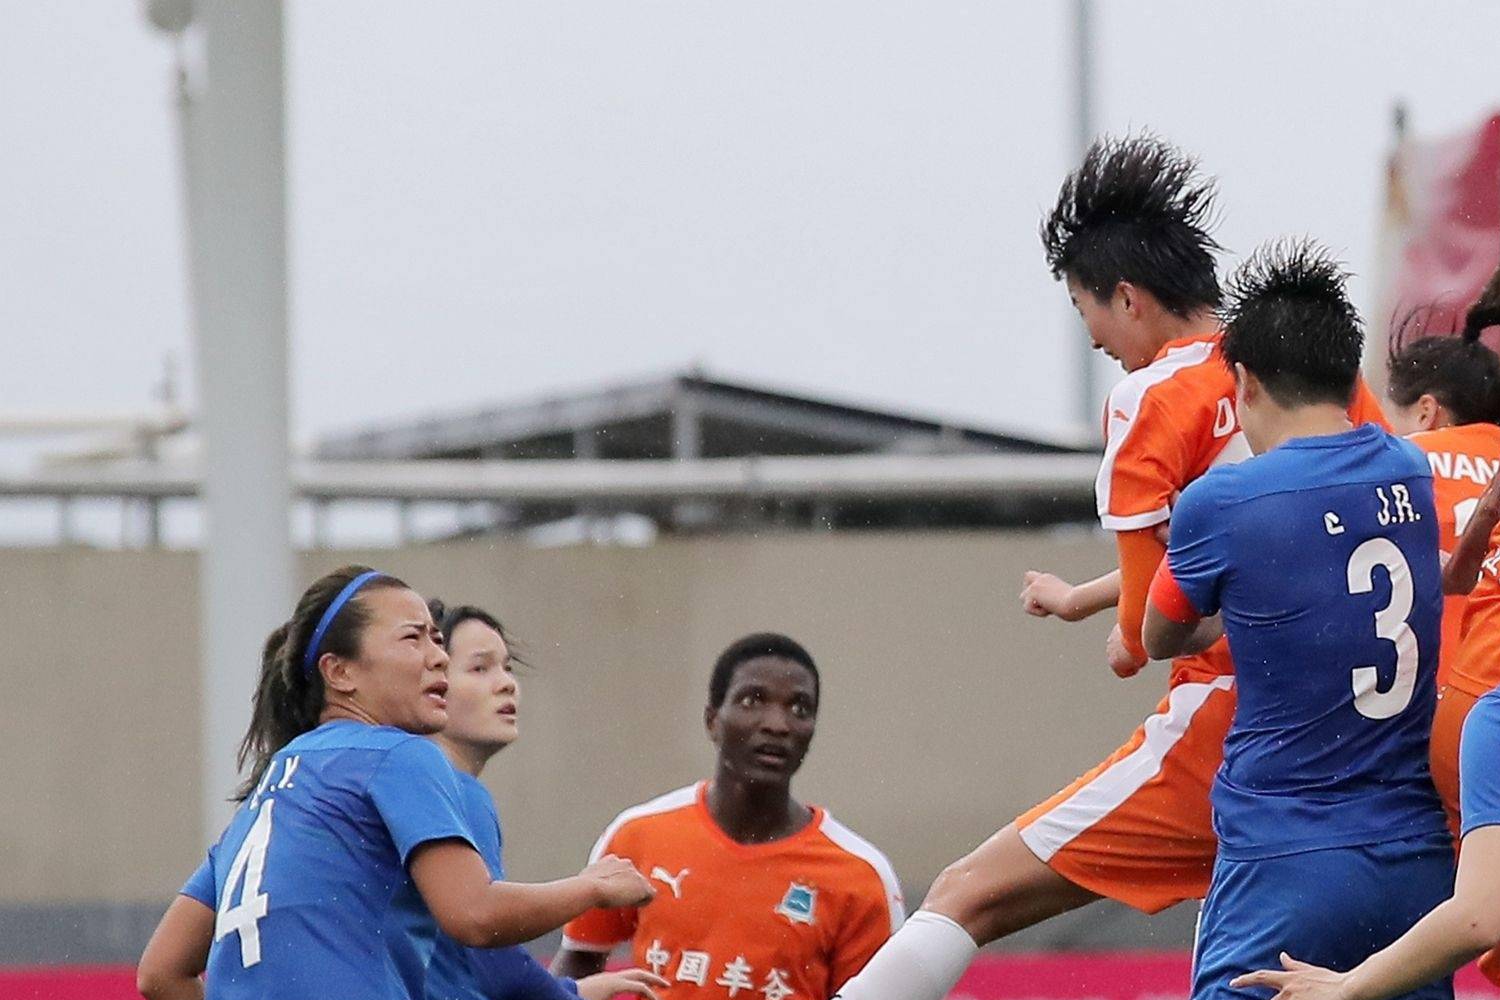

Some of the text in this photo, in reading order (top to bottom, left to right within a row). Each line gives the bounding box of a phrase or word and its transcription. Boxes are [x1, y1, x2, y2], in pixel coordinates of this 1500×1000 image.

[1376, 484, 1421, 526] J.R.
[1347, 537, 1419, 719] 3
[215, 798, 275, 968] 4
